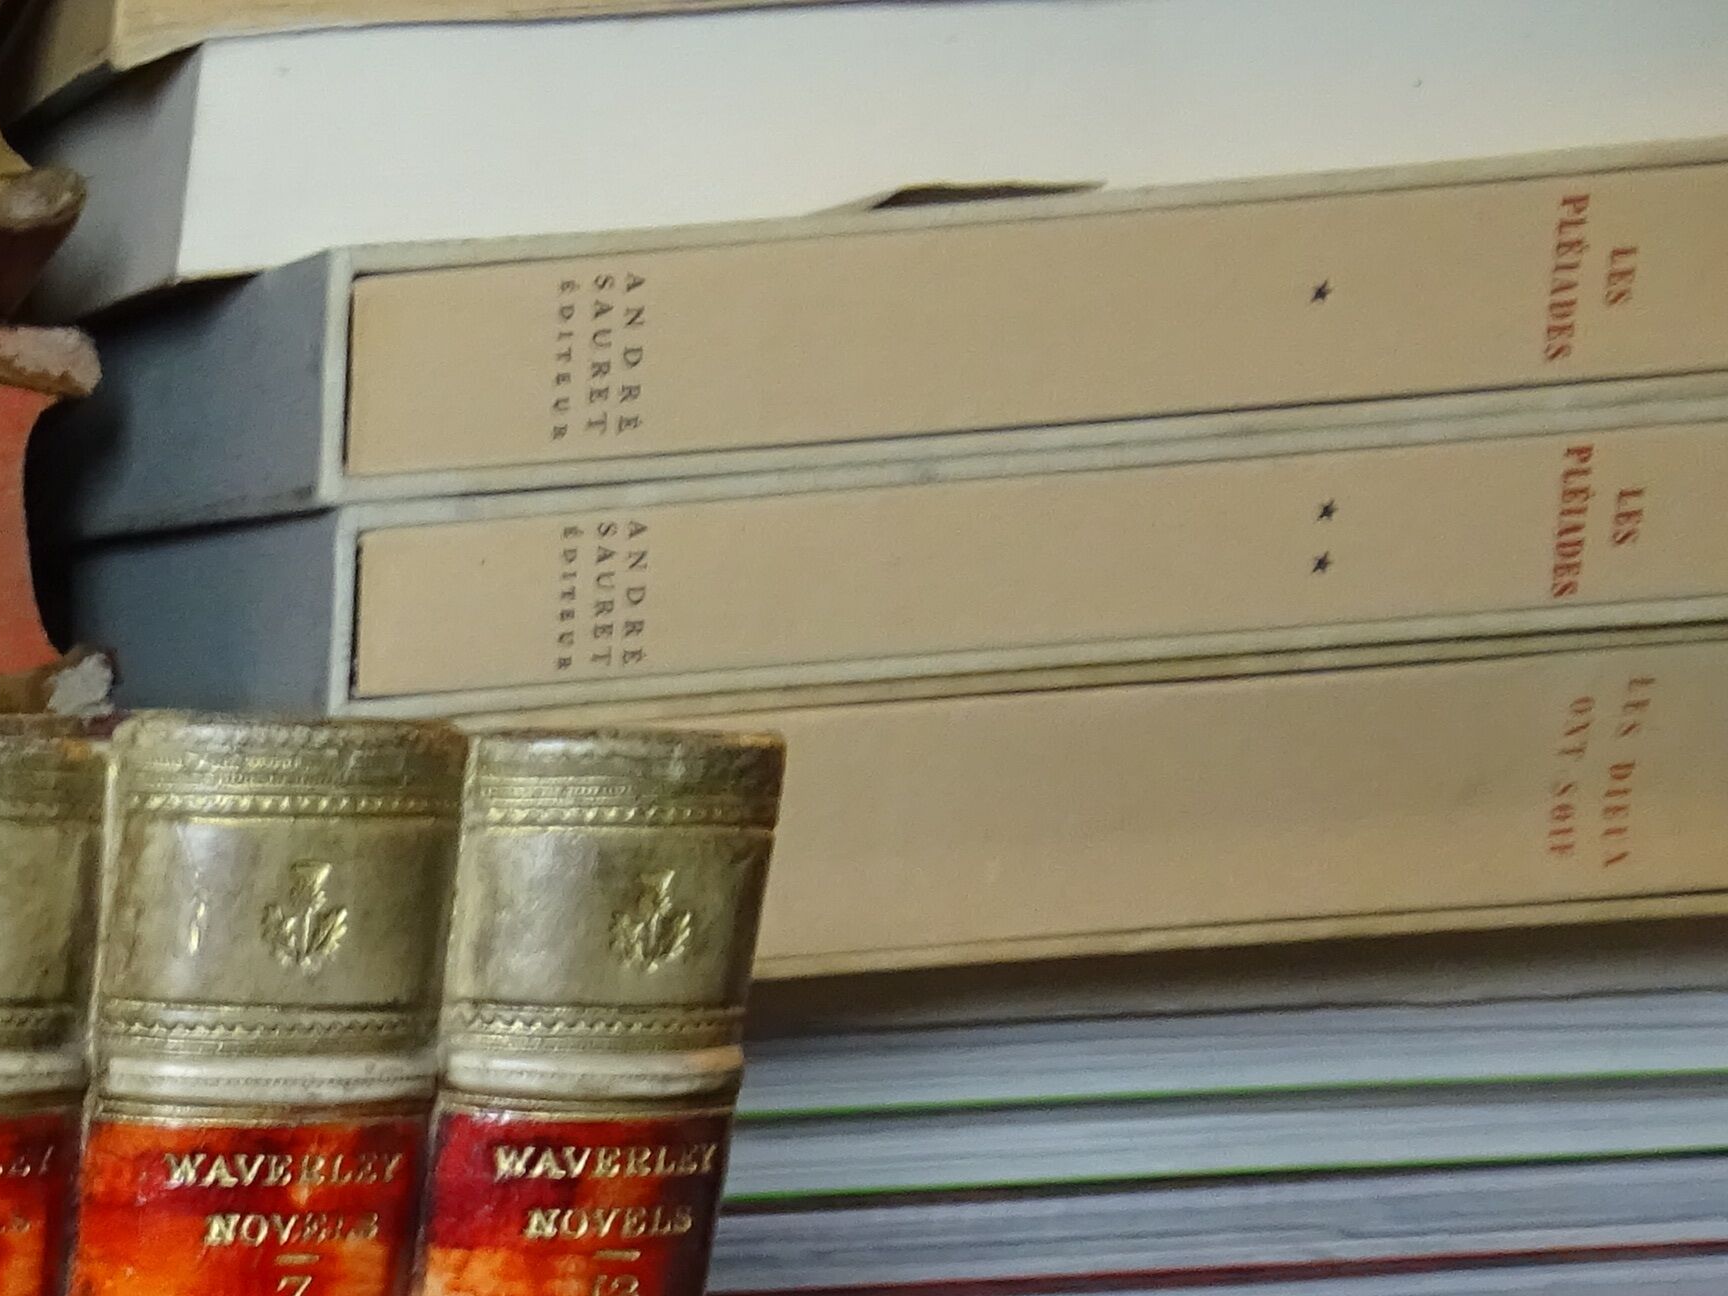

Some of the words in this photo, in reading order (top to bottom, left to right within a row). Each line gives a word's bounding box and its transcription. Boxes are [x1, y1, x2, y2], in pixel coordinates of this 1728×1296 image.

[1545, 194, 1590, 362] PLÉIADES
[1606, 246, 1640, 306] LES
[552, 279, 580, 440] ÉDITEUR
[587, 273, 614, 435] SAURET
[617, 271, 646, 436] ANDRÉ
[1551, 443, 1596, 598] PLÉIADES
[1613, 486, 1646, 546] LES
[557, 526, 585, 670] ÉDITEUR
[591, 521, 618, 666] SAURET
[622, 520, 648, 666] ANDRÉ
[163, 1152, 403, 1188] WAVERLEY
[493, 1143, 719, 1182] WAVERLEY
[523, 1205, 693, 1241] NOVELS
